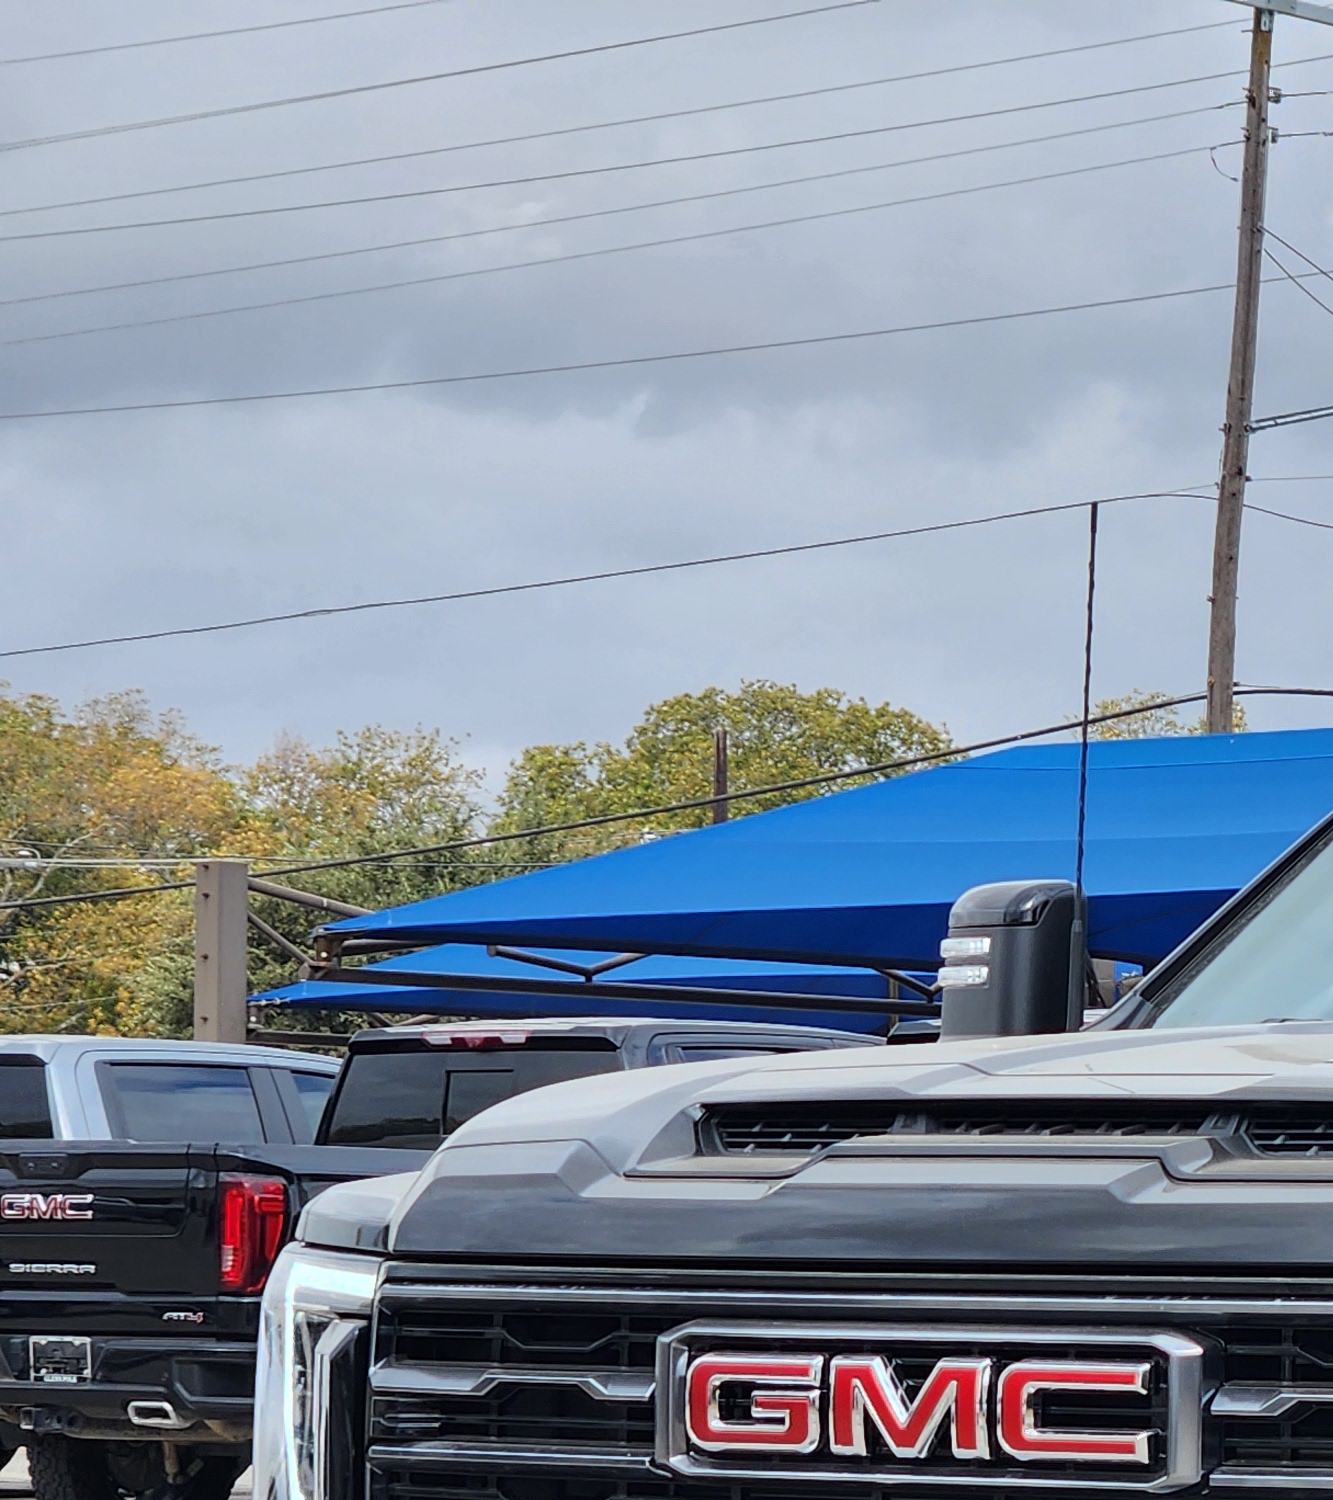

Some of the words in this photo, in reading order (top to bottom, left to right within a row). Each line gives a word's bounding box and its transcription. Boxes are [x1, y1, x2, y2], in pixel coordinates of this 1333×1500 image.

[0, 1193, 95, 1220] GMC
[8, 1263, 97, 1274] SIERRA
[162, 1311, 205, 1324] AT4
[685, 1351, 1164, 1464] GMC
